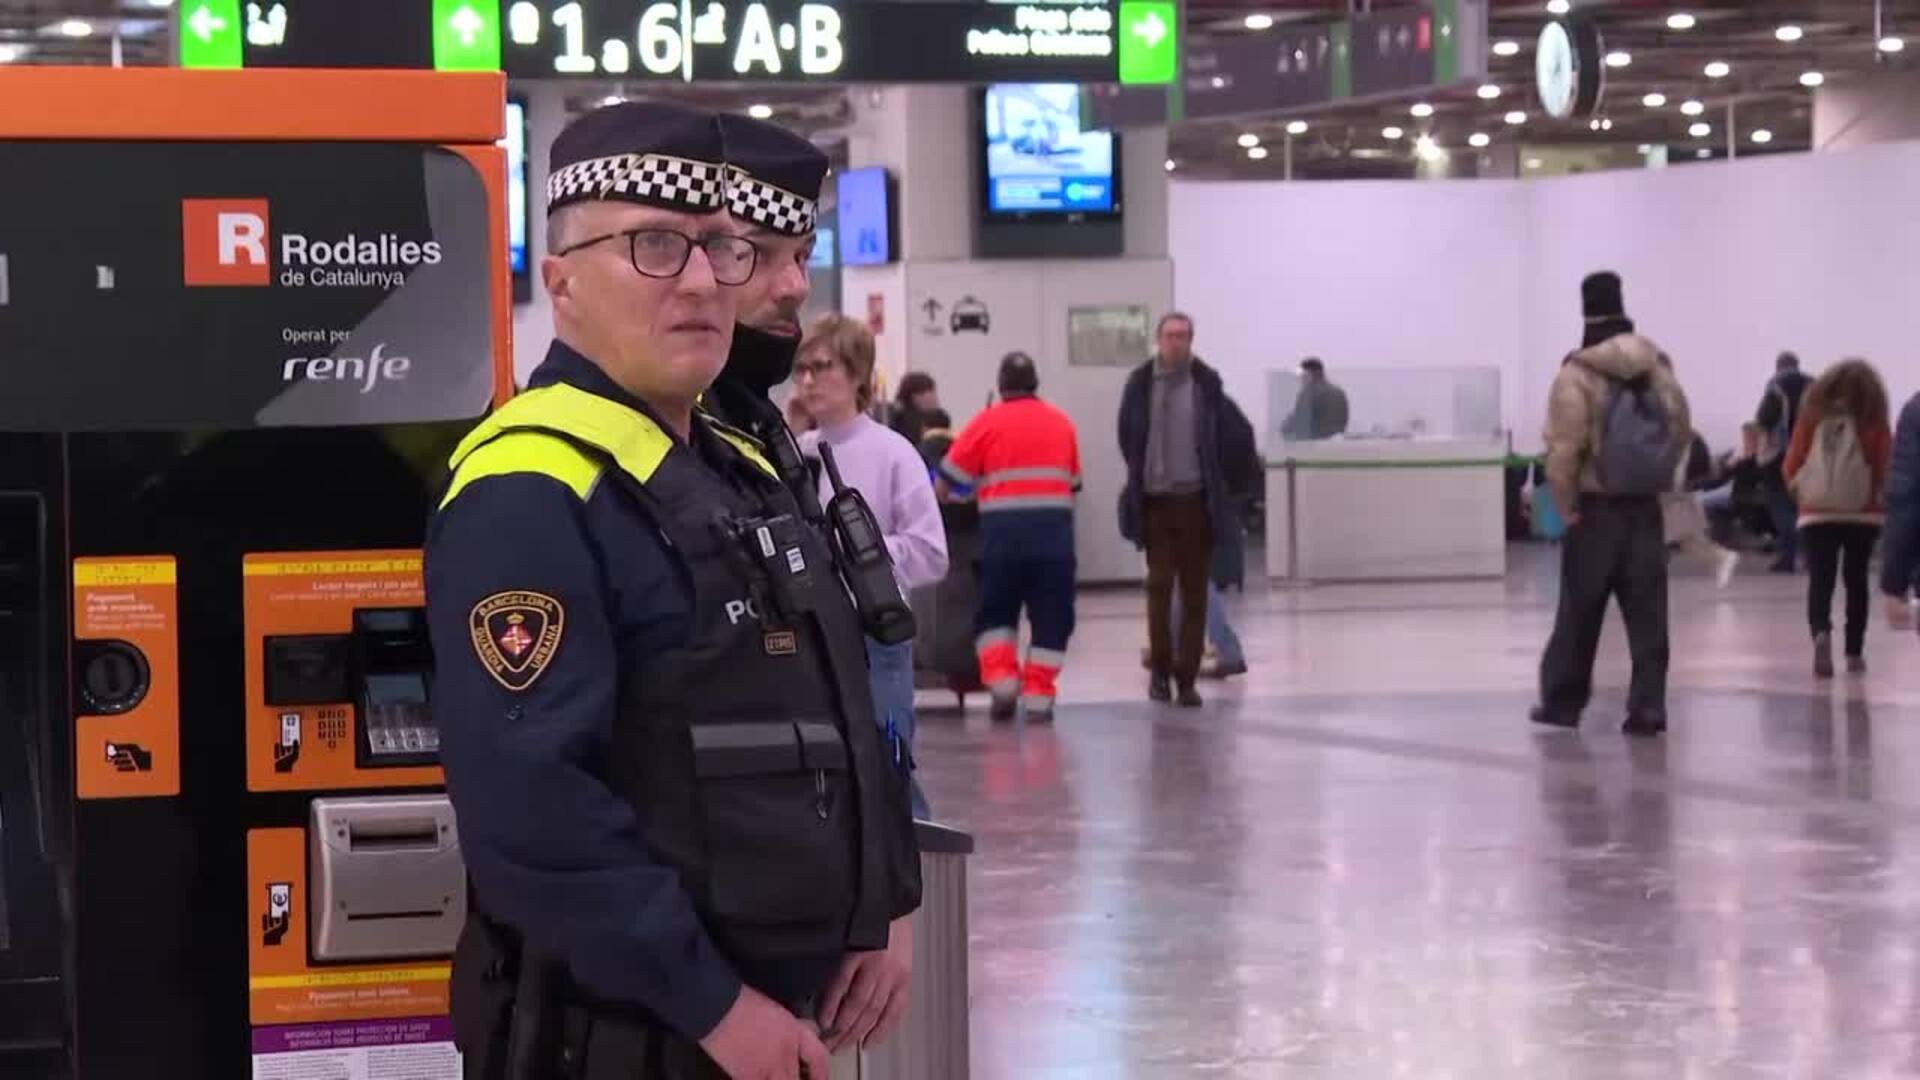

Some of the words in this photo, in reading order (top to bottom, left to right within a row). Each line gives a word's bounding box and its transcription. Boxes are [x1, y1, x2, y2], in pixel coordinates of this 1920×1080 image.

[217, 212, 266, 265] R
[282, 234, 442, 265] Rodalies
[281, 269, 305, 286] de
[310, 268, 404, 290] Catalunya
[282, 328, 325, 343] Operat
[329, 331, 350, 344] per
[283, 343, 411, 394] renfe
[478, 595, 554, 616] BARCELONA
